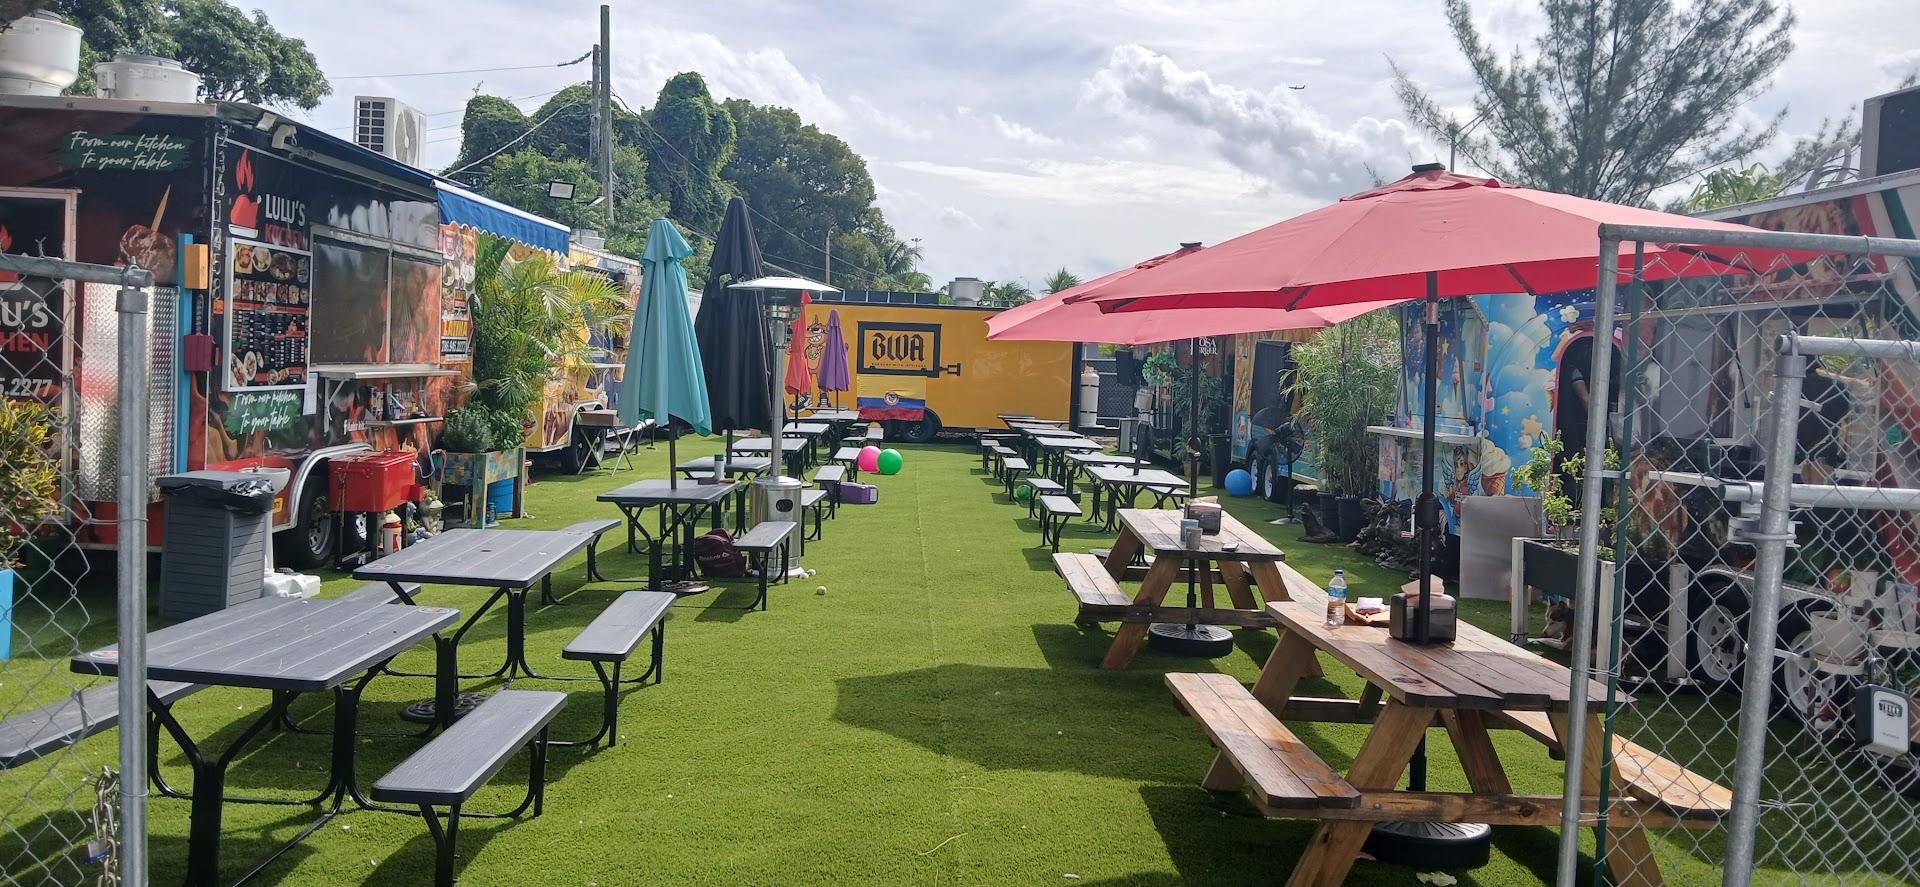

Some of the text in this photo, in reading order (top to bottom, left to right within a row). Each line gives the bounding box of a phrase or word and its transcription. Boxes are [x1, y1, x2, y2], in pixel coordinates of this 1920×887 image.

[71, 130, 185, 152] From our kitchen
[81, 149, 172, 171] to your table
[265, 193, 306, 227] LULU'S
[0, 300, 49, 328] U'S
[872, 332, 924, 362] BWA
[268, 405, 290, 432] table
